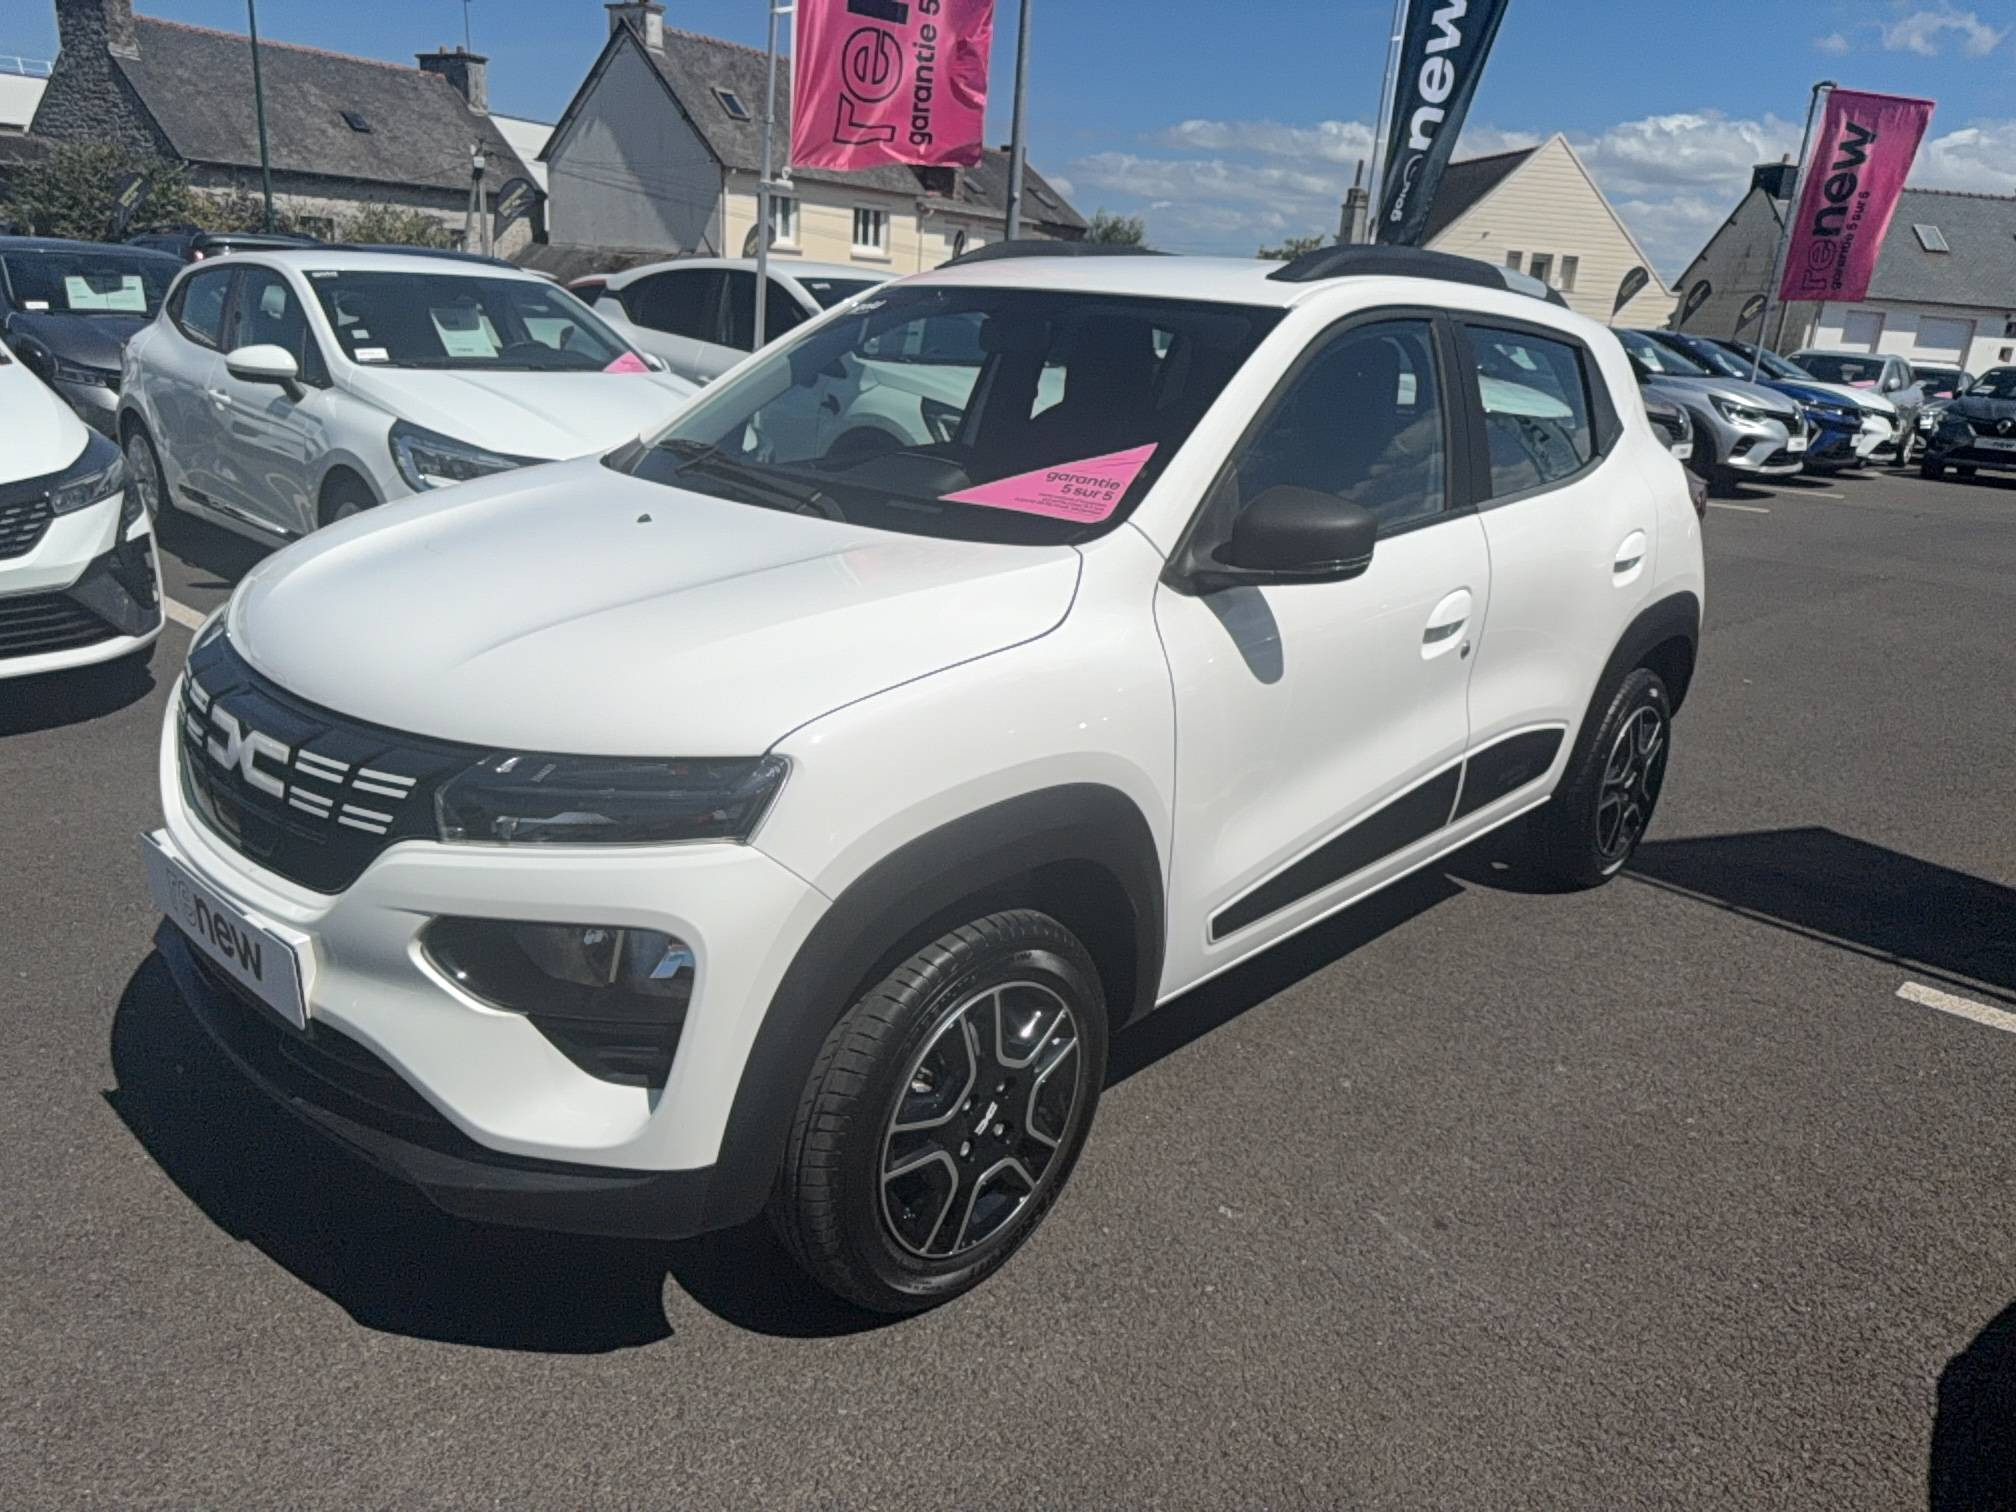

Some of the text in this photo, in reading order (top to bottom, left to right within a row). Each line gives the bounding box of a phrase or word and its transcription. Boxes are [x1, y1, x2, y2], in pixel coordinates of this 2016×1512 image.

[908, 23, 937, 146] garantie
[1802, 121, 1876, 291] renew
[1831, 233, 1855, 290] garantie
[1046, 471, 1121, 491] garantie
[1060, 484, 1074, 494] 5
[1073, 487, 1101, 499] sur
[1102, 490, 1116, 501] 5
